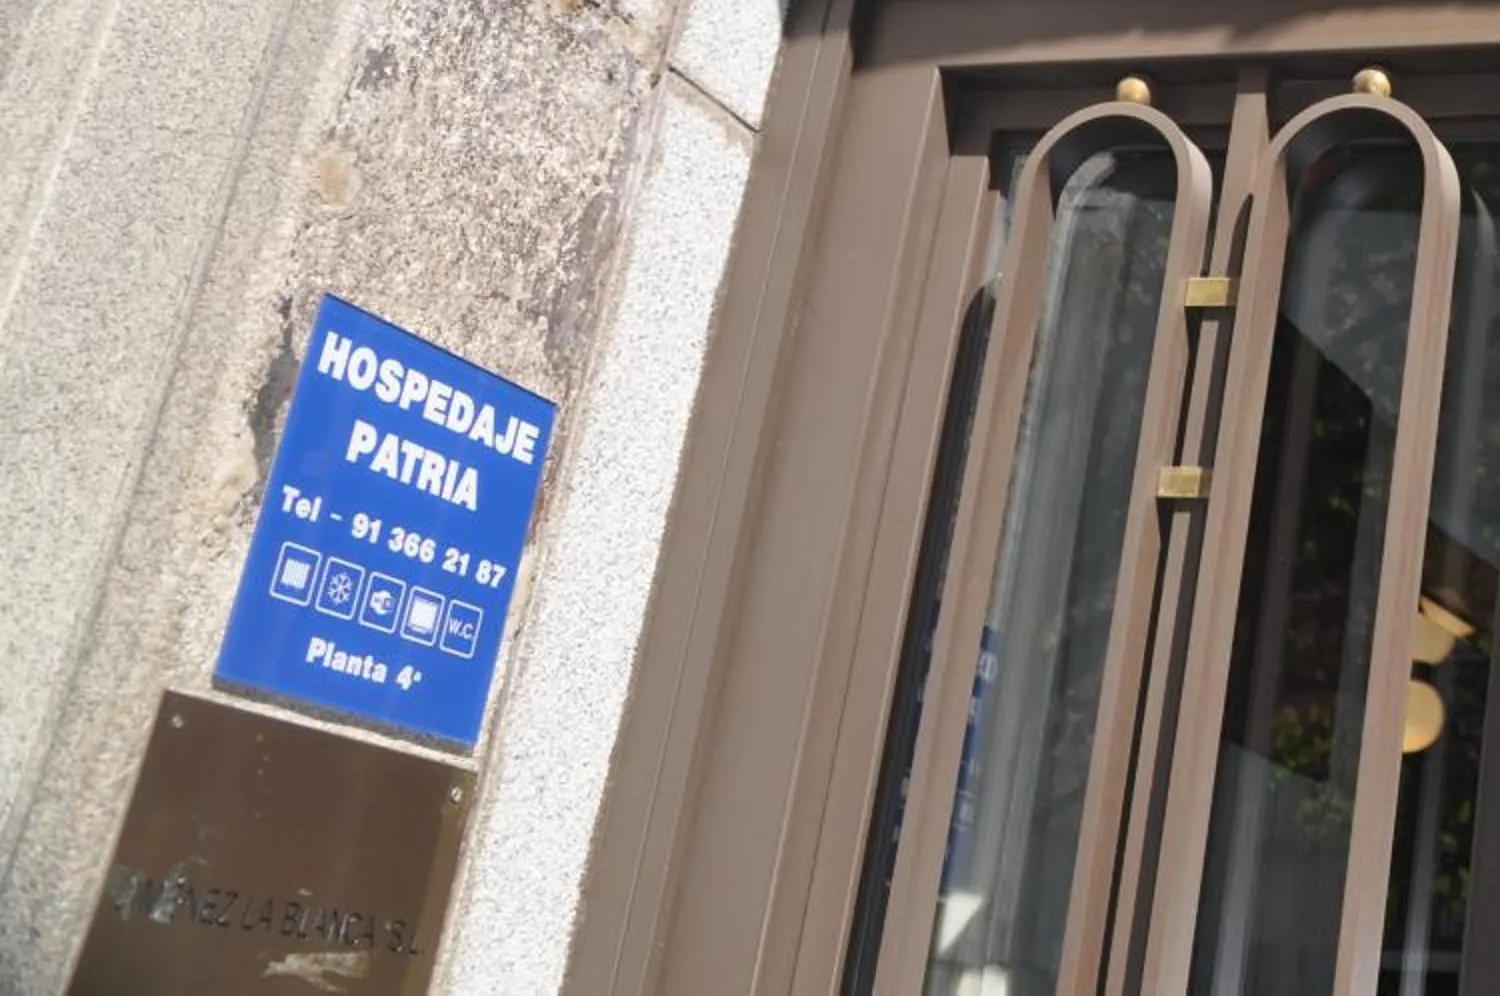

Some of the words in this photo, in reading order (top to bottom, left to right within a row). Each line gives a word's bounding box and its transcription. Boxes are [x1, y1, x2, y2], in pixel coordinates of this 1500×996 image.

[317, 331, 541, 465] HOSPEDAJE
[345, 419, 479, 511] PATRIA
[282, 484, 323, 522] Tel
[351, 512, 382, 544] 91
[387, 526, 437, 564] 366
[441, 547, 471, 577] 21
[474, 559, 507, 589] 87
[305, 635, 389, 684] Planta
